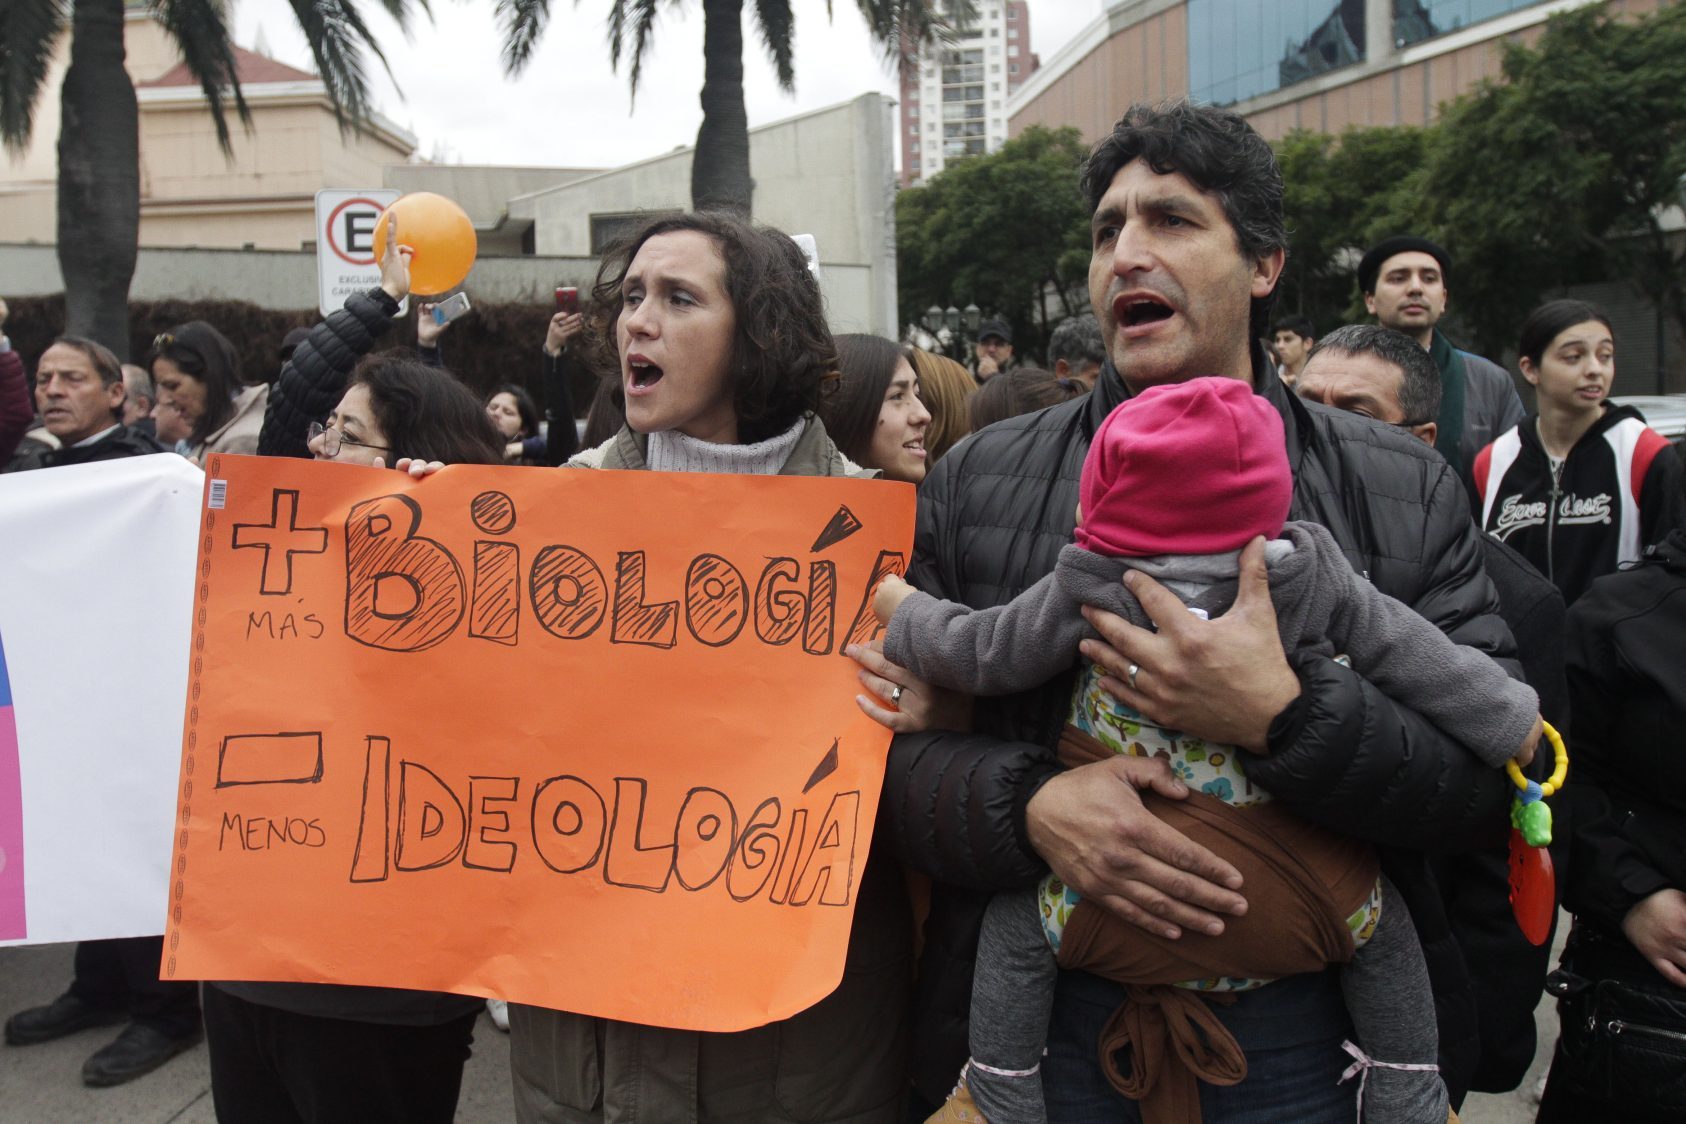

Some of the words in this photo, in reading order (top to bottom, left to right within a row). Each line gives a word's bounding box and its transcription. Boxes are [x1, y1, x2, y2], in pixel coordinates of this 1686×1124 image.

[345, 212, 376, 252] E
[246, 598, 324, 639] MÁS
[219, 812, 326, 851] MENOS
[350, 735, 860, 906] IDEOLOGÍA
